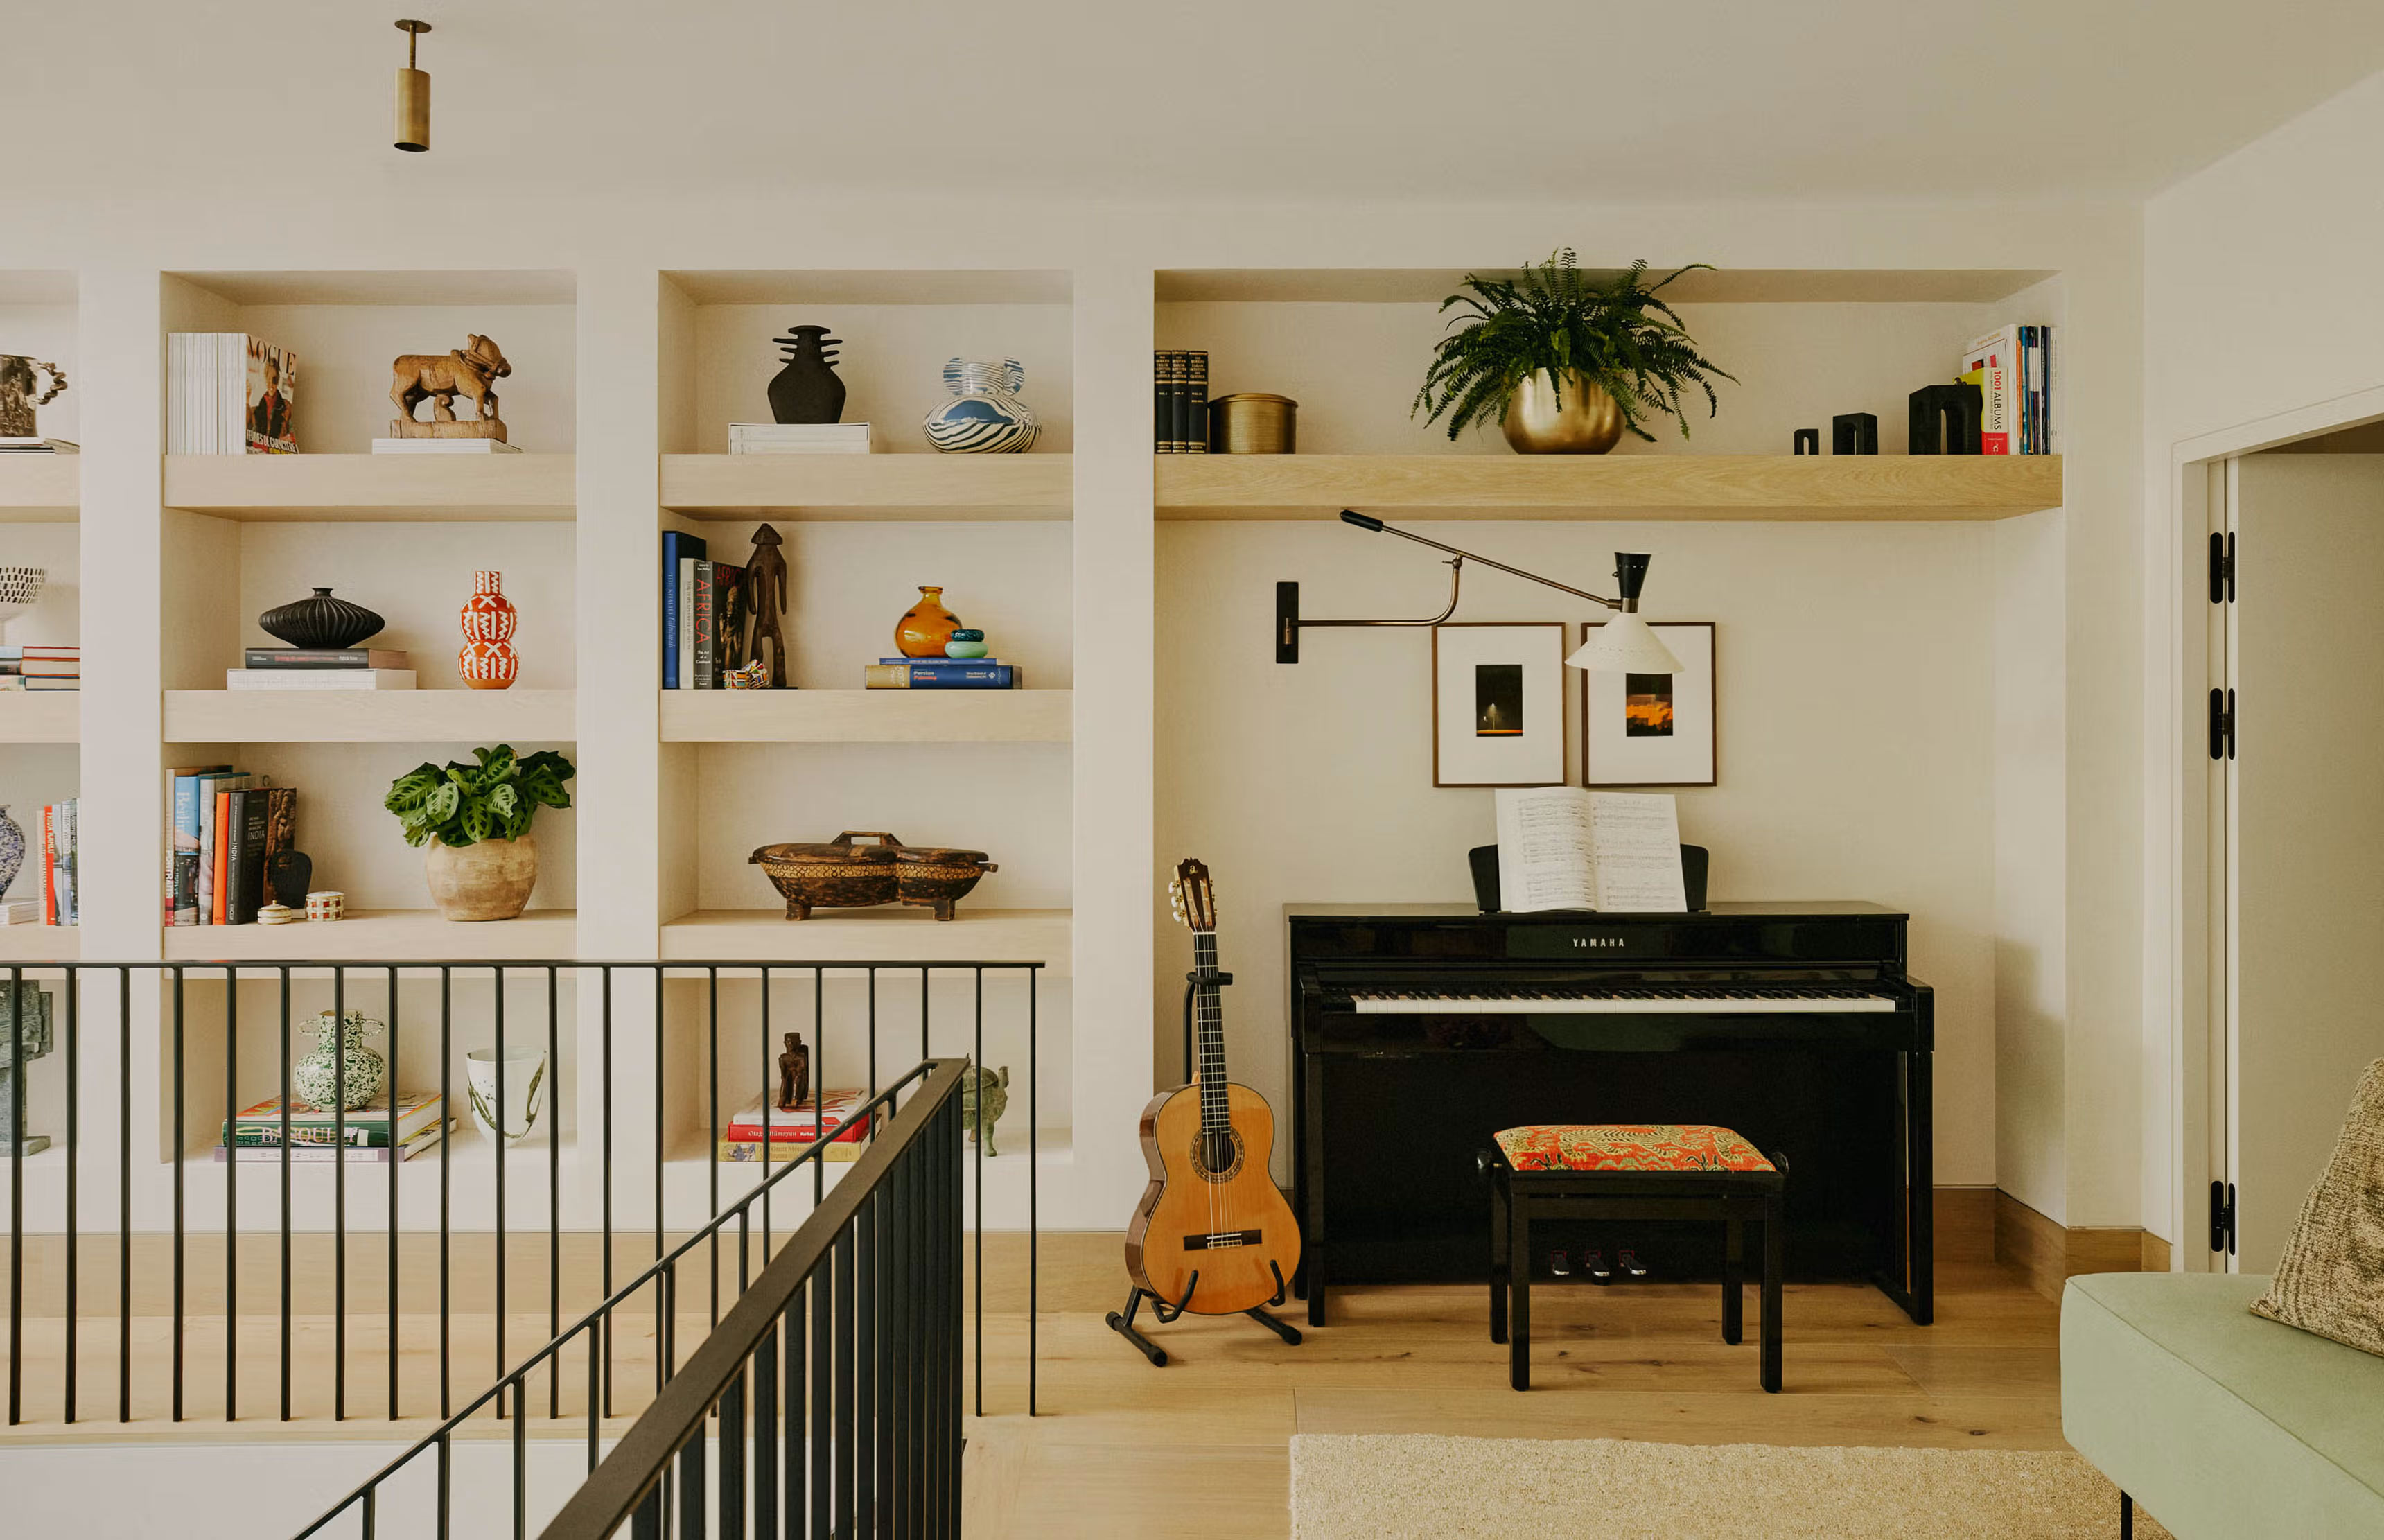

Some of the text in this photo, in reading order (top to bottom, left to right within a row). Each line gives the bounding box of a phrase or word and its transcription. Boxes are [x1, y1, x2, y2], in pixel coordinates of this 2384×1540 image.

[247, 335, 296, 375] VOGUE
[695, 579, 712, 644] AFRICA
[177, 791, 190, 832] Berlin
[247, 830, 265, 840] INDIA
[1572, 938, 1624, 947] YAMAHA
